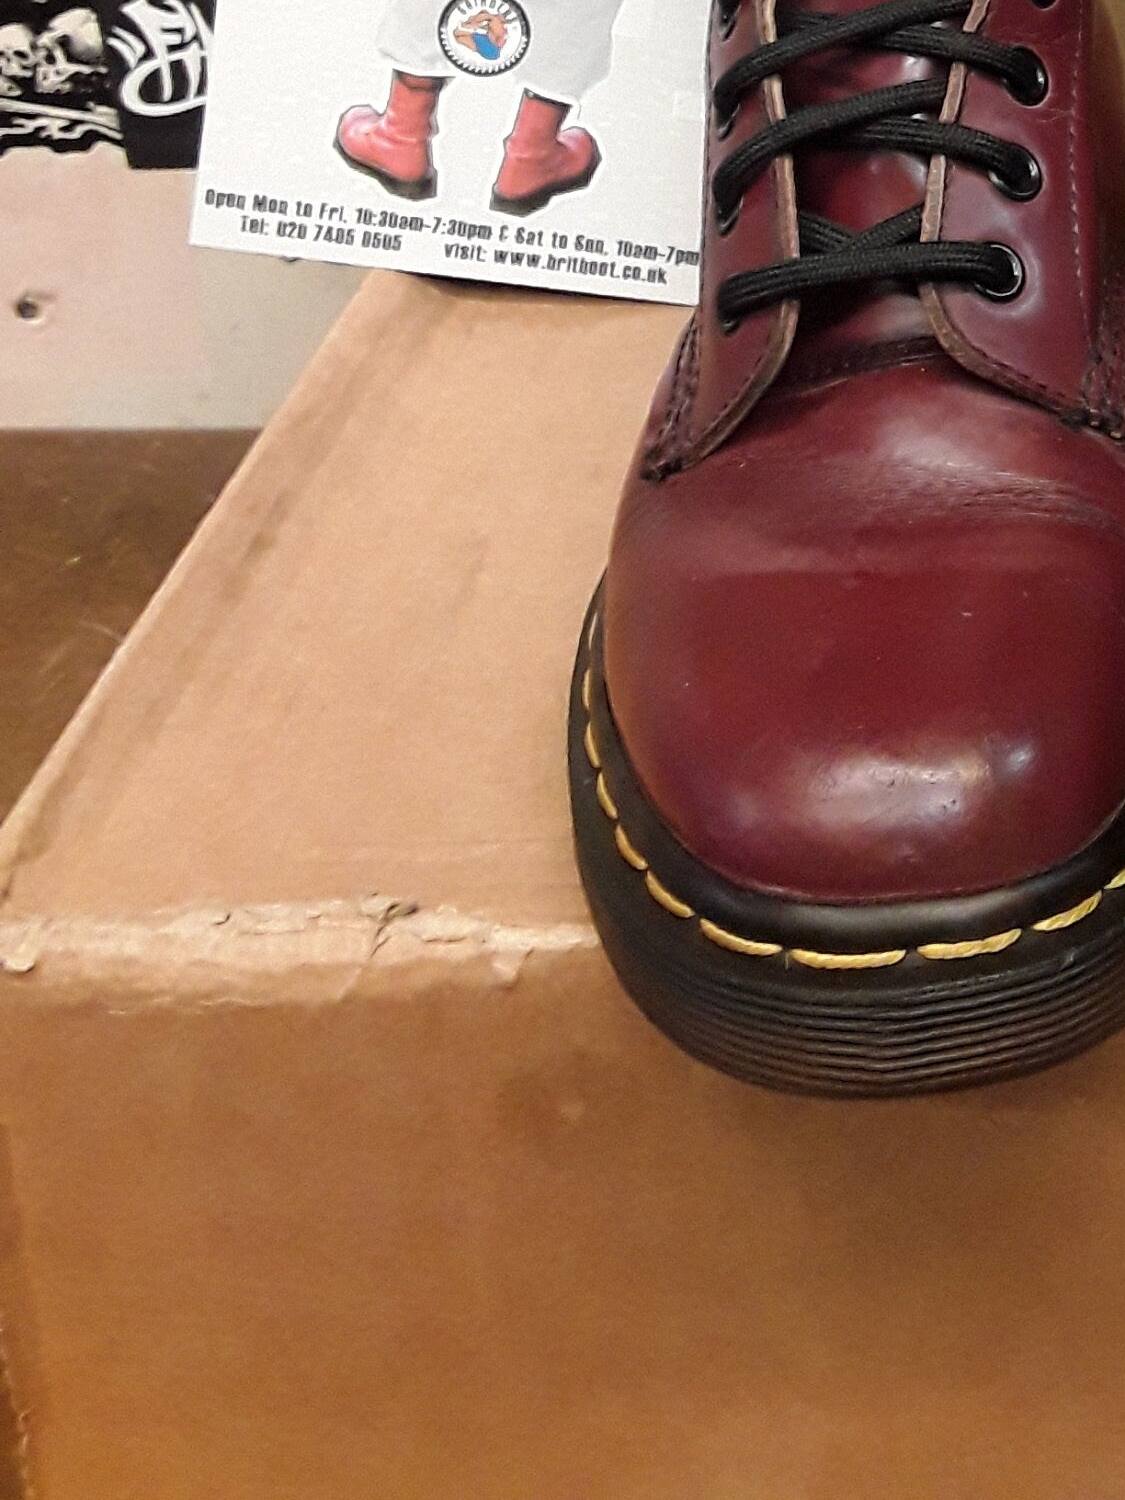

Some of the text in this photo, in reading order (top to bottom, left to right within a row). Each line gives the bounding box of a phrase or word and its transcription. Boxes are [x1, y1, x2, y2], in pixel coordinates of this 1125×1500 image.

[204, 188, 246, 210] Open
[252, 194, 288, 216] Mon
[514, 226, 543, 248] Sat
